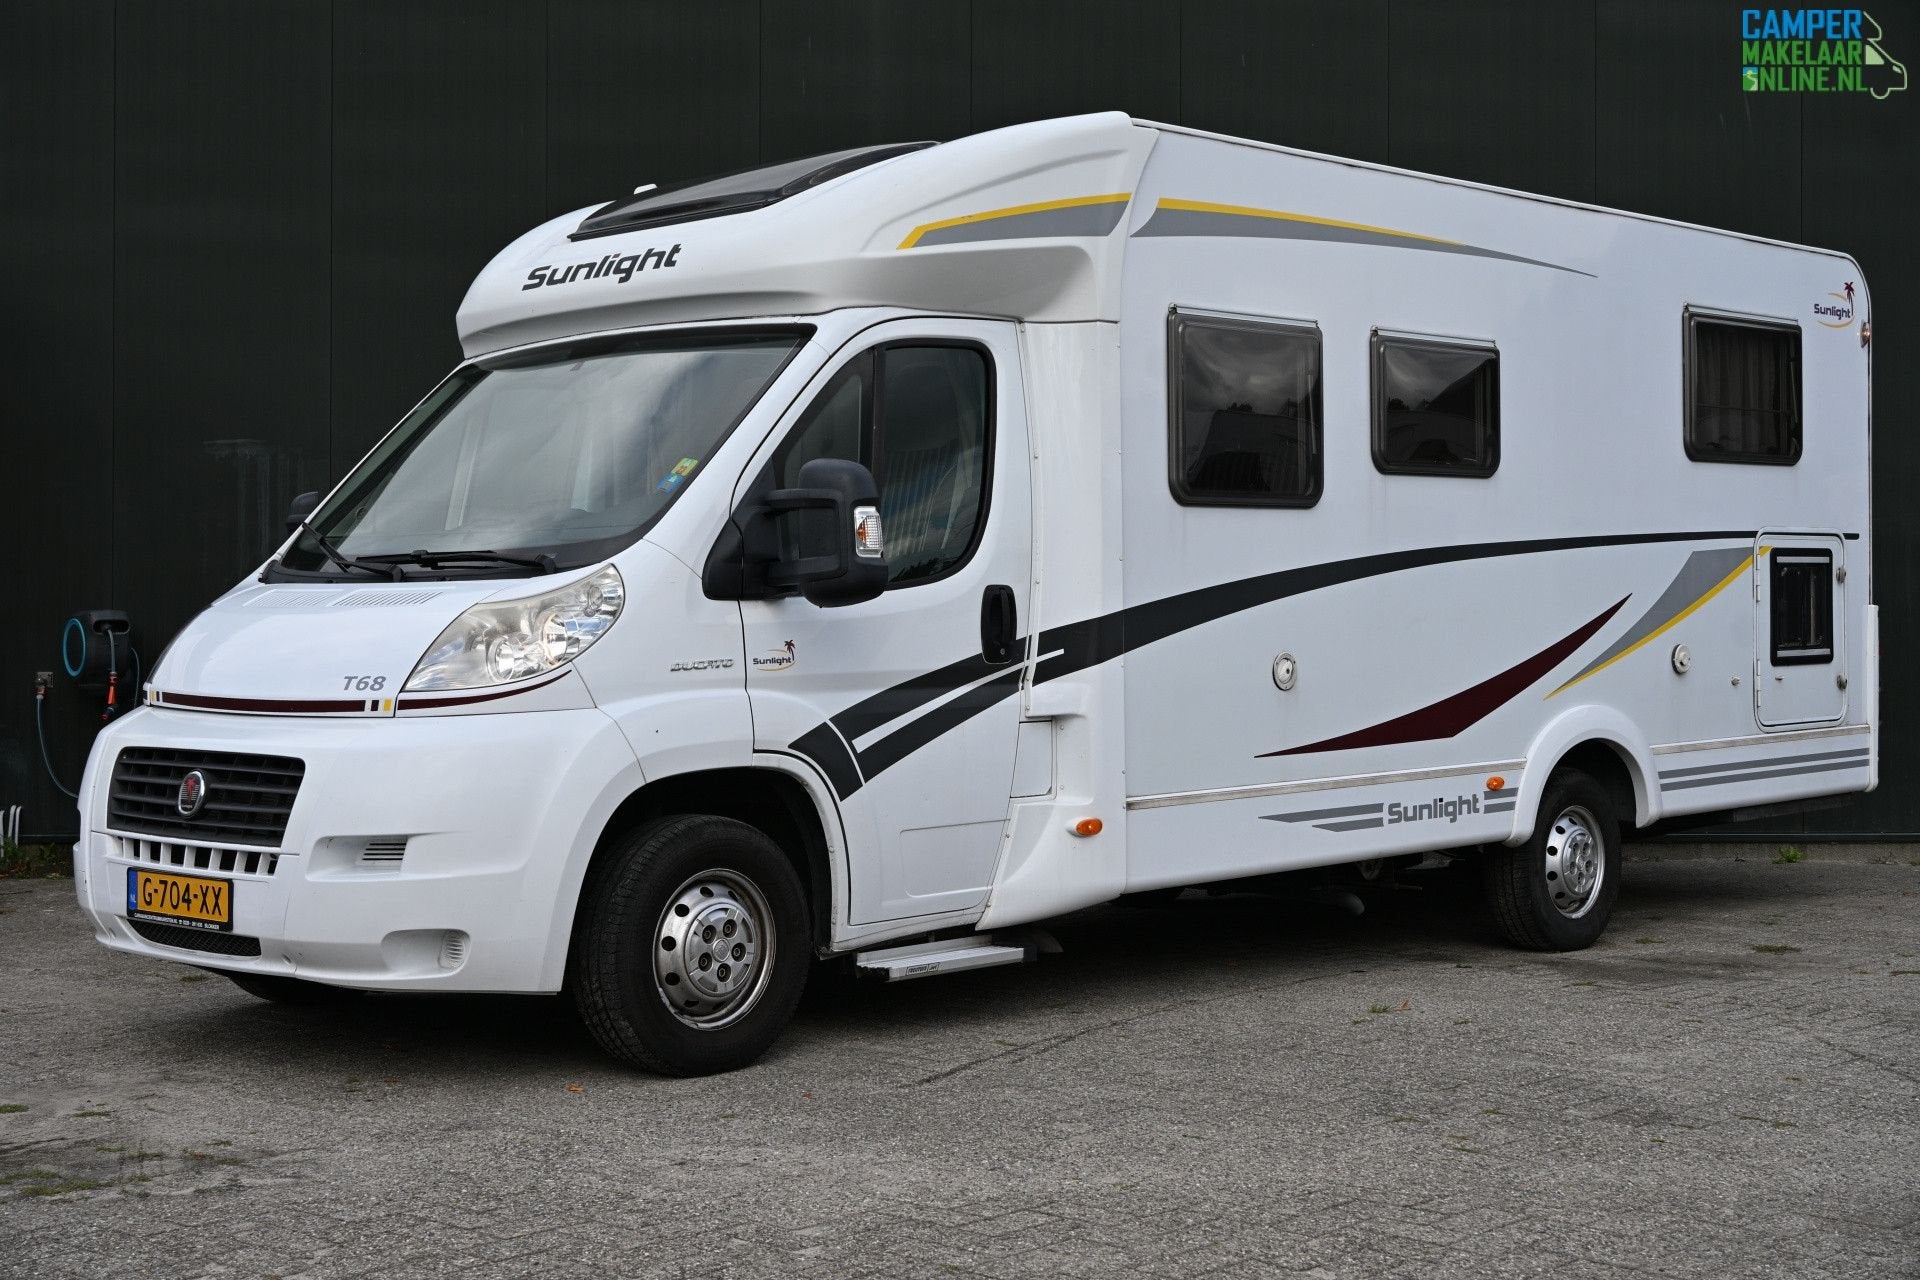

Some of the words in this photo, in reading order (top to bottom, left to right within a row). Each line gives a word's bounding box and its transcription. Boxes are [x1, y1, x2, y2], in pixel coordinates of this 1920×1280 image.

[521, 243, 682, 291] Sunlight
[1813, 303, 1851, 320] Sunlight
[752, 656, 792, 666] Sunlight
[343, 675, 387, 691] T68
[1387, 793, 1480, 825] Sunlight
[142, 877, 222, 916] G-704-XX
